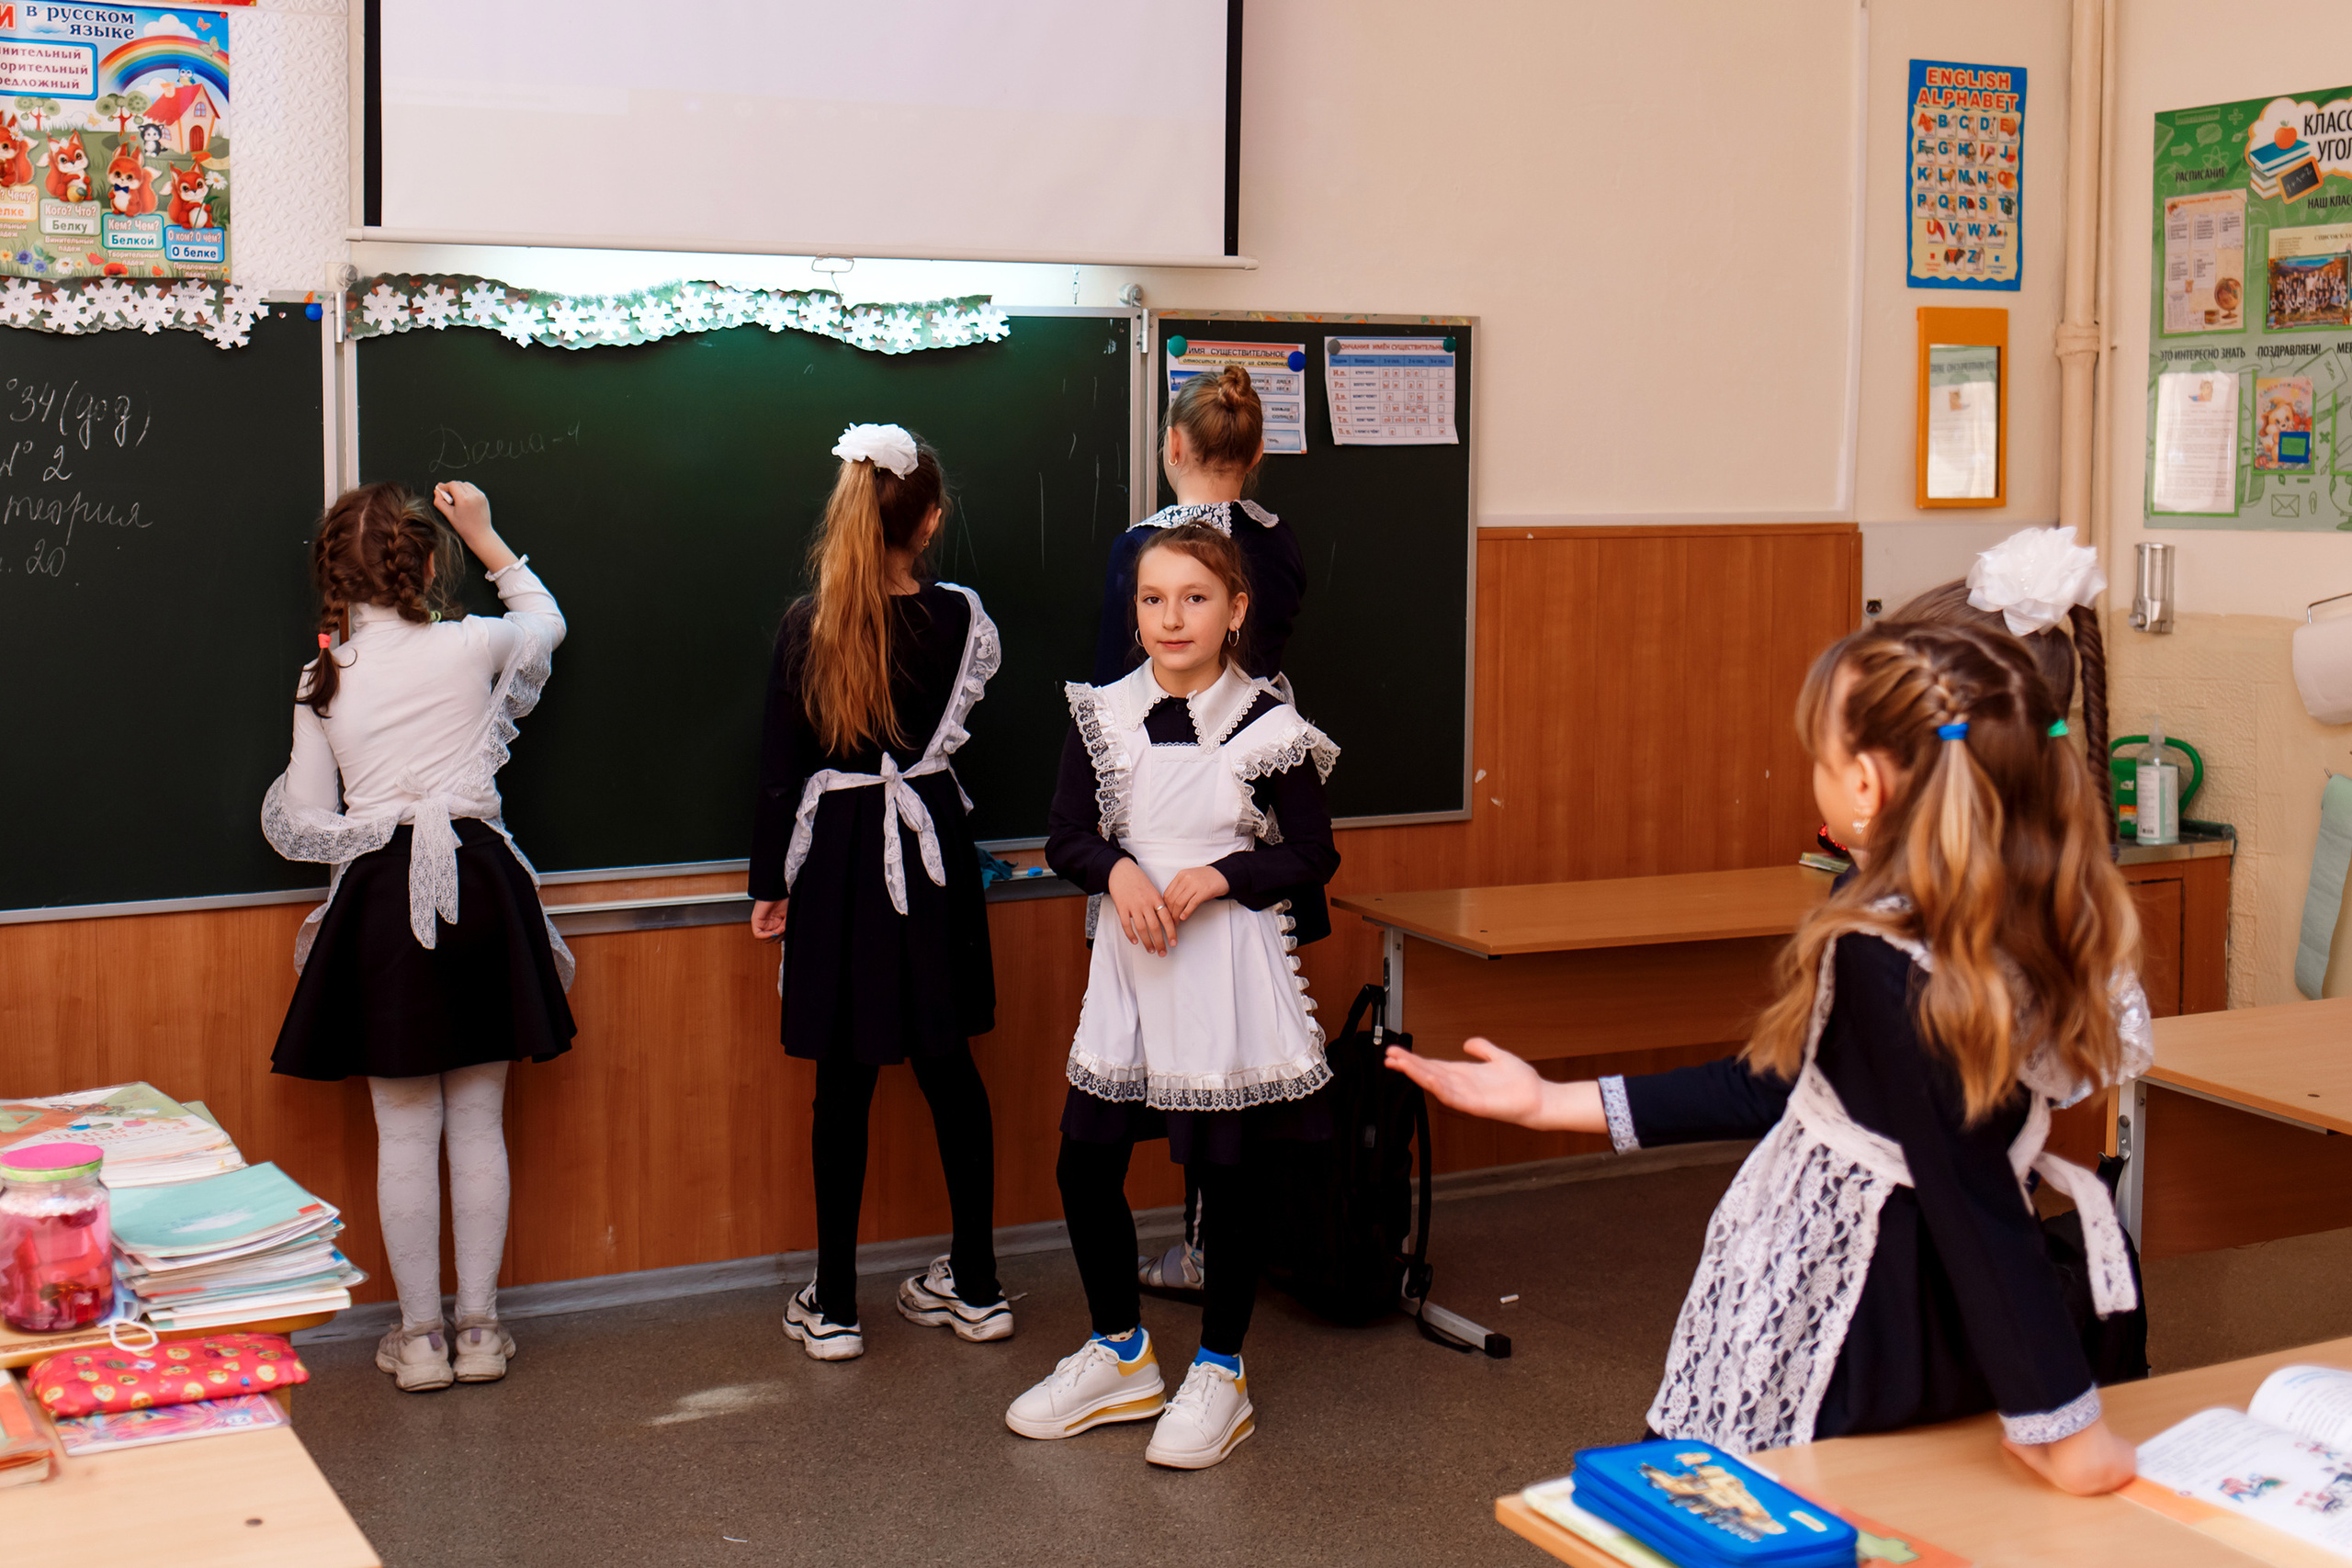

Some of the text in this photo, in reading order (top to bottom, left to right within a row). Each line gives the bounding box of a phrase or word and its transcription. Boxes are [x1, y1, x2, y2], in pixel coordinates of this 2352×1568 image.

[27, 6, 38, 17] в
[47, 6, 134, 25] русском
[70, 24, 135, 39] языке
[0, 47, 82, 60] нительный
[1927, 67, 2011, 90] ENGLISH
[1917, 88, 2018, 111] ALPHABET
[1939, 115, 1948, 128] B
[1959, 116, 1969, 129] C
[1980, 117, 1989, 130] D
[2000, 118, 2009, 131] E
[1918, 140, 1926, 152] F
[1939, 141, 1948, 154] G
[1958, 142, 1968, 156] H
[2000, 145, 2007, 158] J
[1917, 167, 2007, 184] K L M N O
[2175, 166, 2226, 183] РАСПИСАНИЕ
[8, 189, 37, 204] Чему?
[1917, 194, 1927, 207] P
[1959, 196, 1968, 209] R
[1979, 197, 1988, 210] S
[1998, 197, 2007, 210] T
[2307, 195, 2352, 209] НАШ КЛАС
[45, 204, 96, 217] Кого? Что?
[52, 220, 88, 233] Белку
[107, 219, 160, 231] Кем? Чем?
[1927, 220, 1997, 236] U V W X
[44, 235, 95, 244] Винительный
[111, 234, 154, 246] Белкой
[107, 249, 160, 259] Творительный
[172, 246, 217, 258] О белке
[1967, 250, 1976, 263] Z
[1211, 348, 1285, 358] СУЩЕСТВИТЕЛЬНОЕ
[2161, 346, 2245, 362] ЭТО ИНТЕРЕСНО ЗНАТЬ
[2257, 343, 2321, 358] ПОЗДРАВЛЯЕМ!
[43, 445, 73, 482] 2
[26, 538, 65, 578] 20
